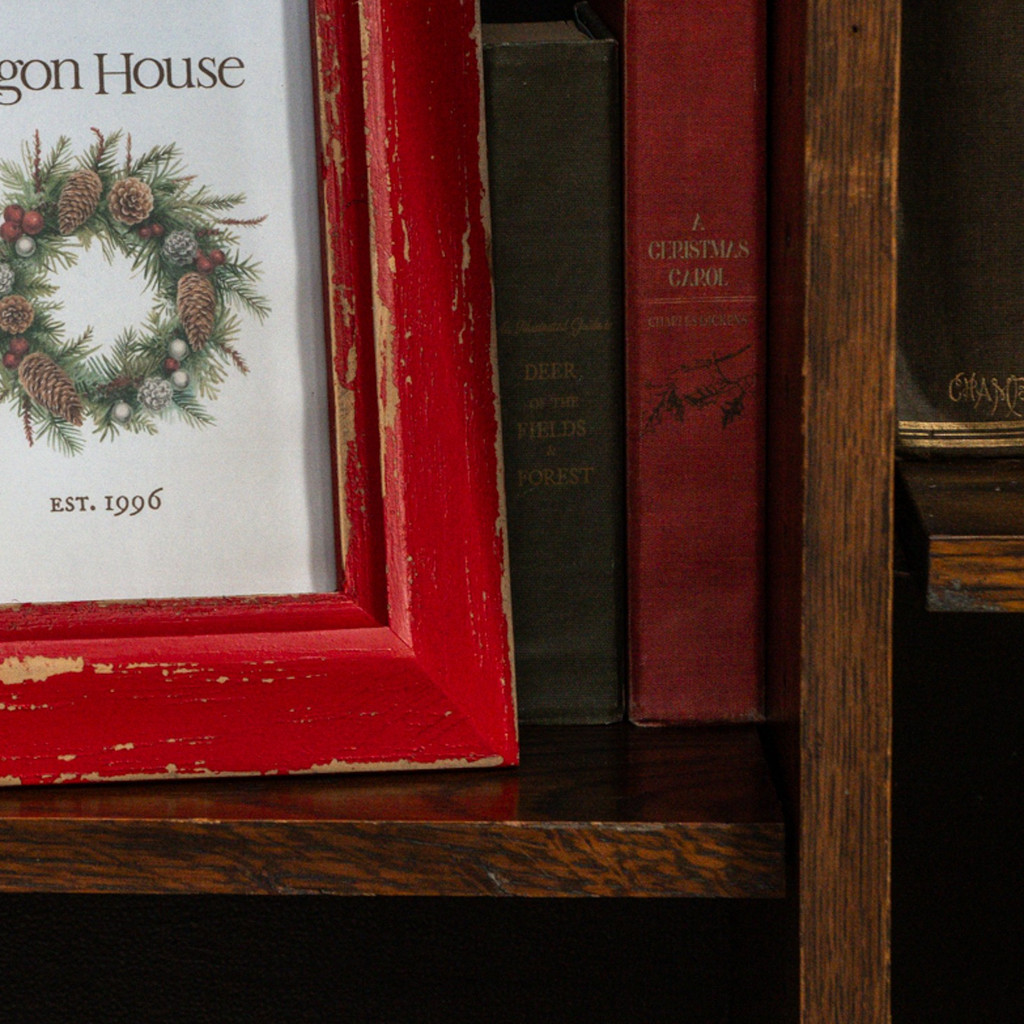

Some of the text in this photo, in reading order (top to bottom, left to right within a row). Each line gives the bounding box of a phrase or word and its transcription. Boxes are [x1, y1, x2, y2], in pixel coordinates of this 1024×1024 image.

[94, 52, 246, 95] House
[691, 212, 706, 232] A
[648, 238, 751, 261] CHRISTMAS
[668, 266, 729, 288] CAROL
[517, 419, 587, 441] FIELDS
[517, 467, 594, 487] FOREST
[49, 487, 164, 517] EST. 1996
